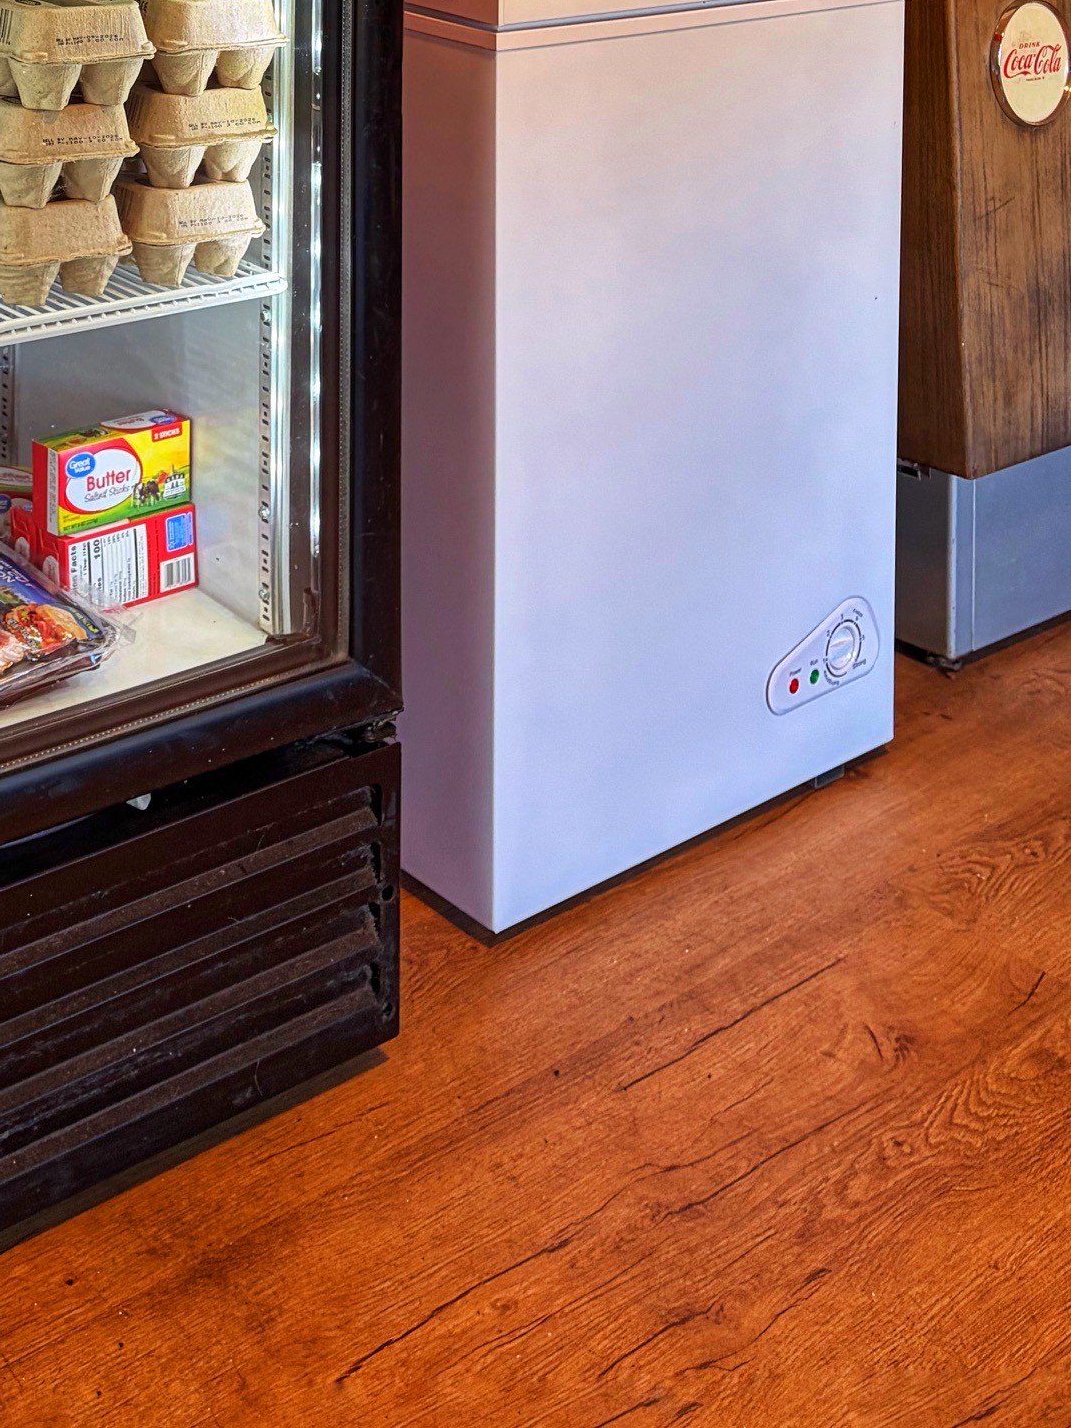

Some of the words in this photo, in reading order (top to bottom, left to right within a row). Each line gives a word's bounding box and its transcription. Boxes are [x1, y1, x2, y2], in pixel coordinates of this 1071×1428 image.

[1019, 42, 1040, 50] DRINK
[1004, 43, 1062, 79] Coca-Cola
[160, 427, 180, 439] STICKS
[69, 457, 91, 470] Great
[75, 465, 91, 473] Value
[87, 469, 131, 492] Butter
[84, 490, 108, 503] Salted
[108, 485, 130, 497] Sticks
